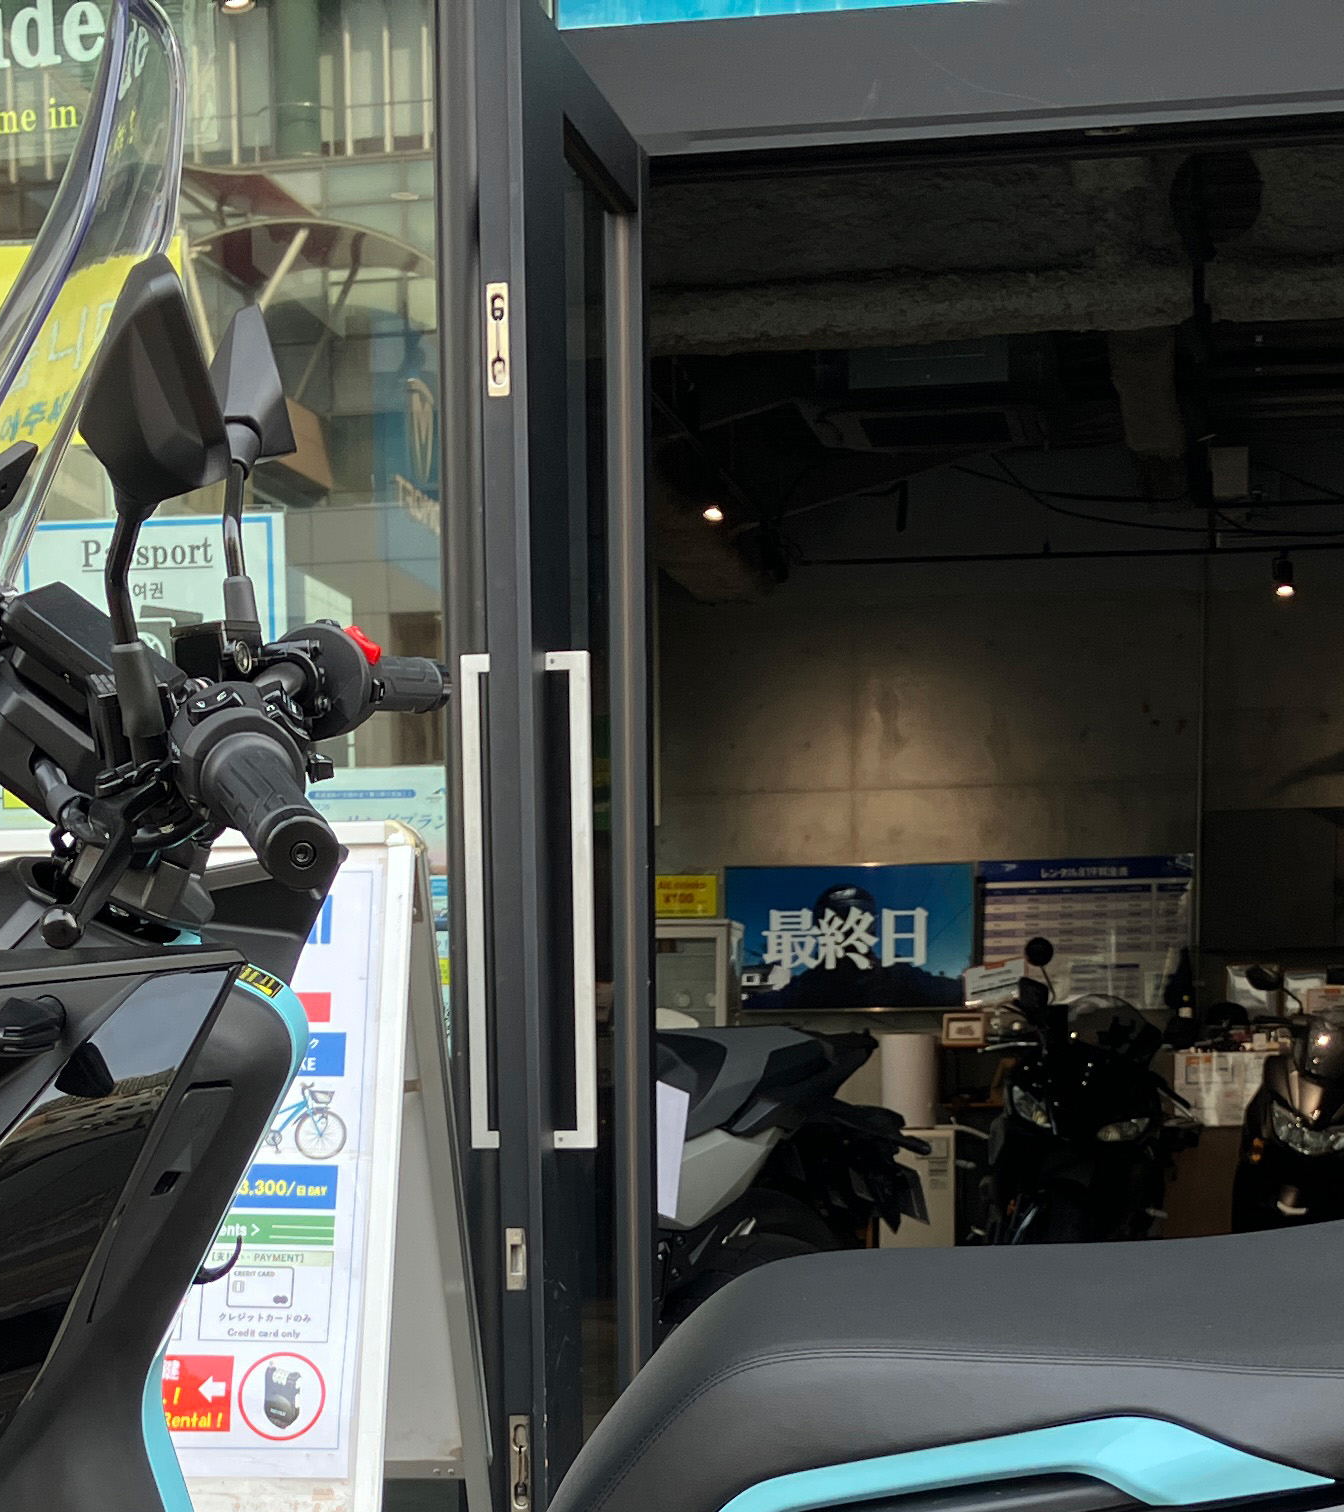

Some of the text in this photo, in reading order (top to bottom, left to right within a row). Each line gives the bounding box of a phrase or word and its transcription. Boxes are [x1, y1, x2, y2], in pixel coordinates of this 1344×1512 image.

[47, 97, 78, 129] in
[81, 537, 213, 571] Psport
[132, 582, 164, 600] 여권
[761, 906, 929, 971] 最終日
[218, 1313, 312, 1324] クレジットカードのみ
[227, 1328, 301, 1339] Credit card only
